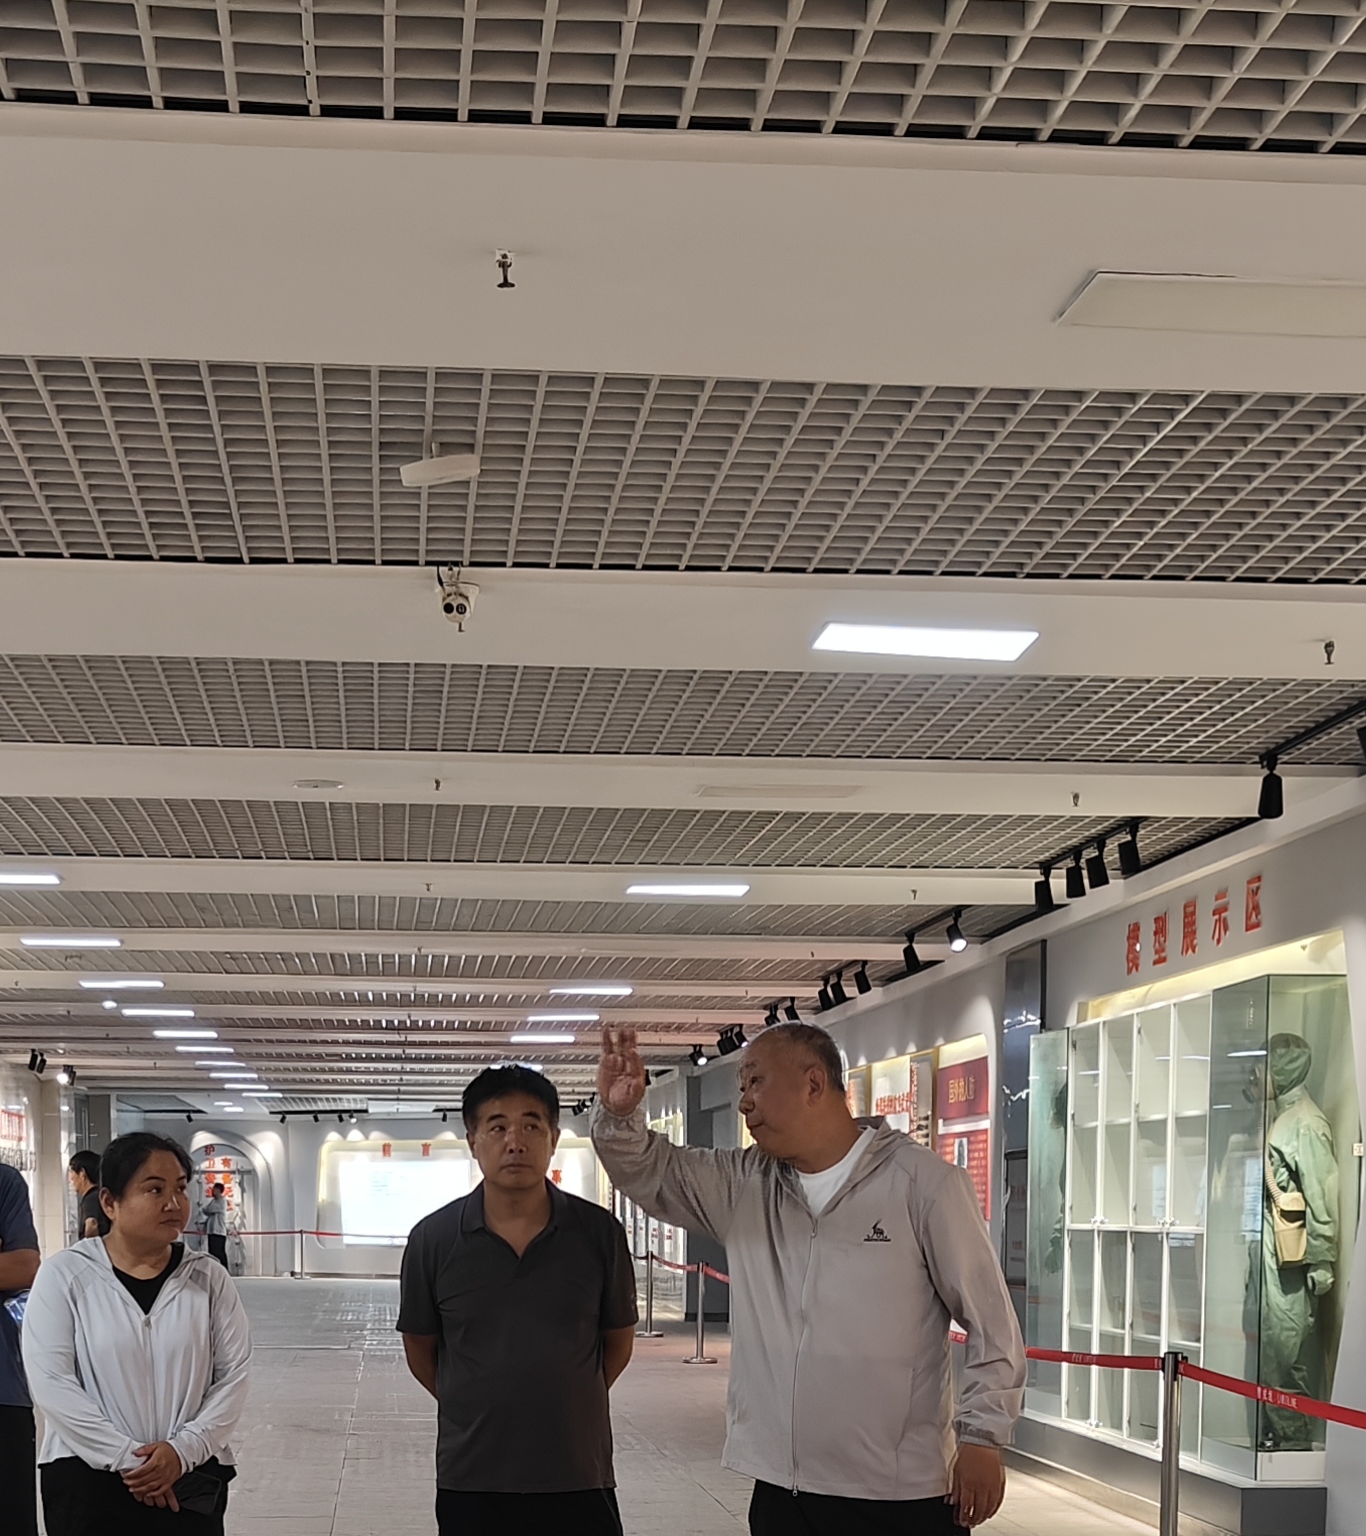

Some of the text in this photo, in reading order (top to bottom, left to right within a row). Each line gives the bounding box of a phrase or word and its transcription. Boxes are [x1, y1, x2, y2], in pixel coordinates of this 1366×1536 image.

[1126, 875, 1262, 975] 模型展示区
